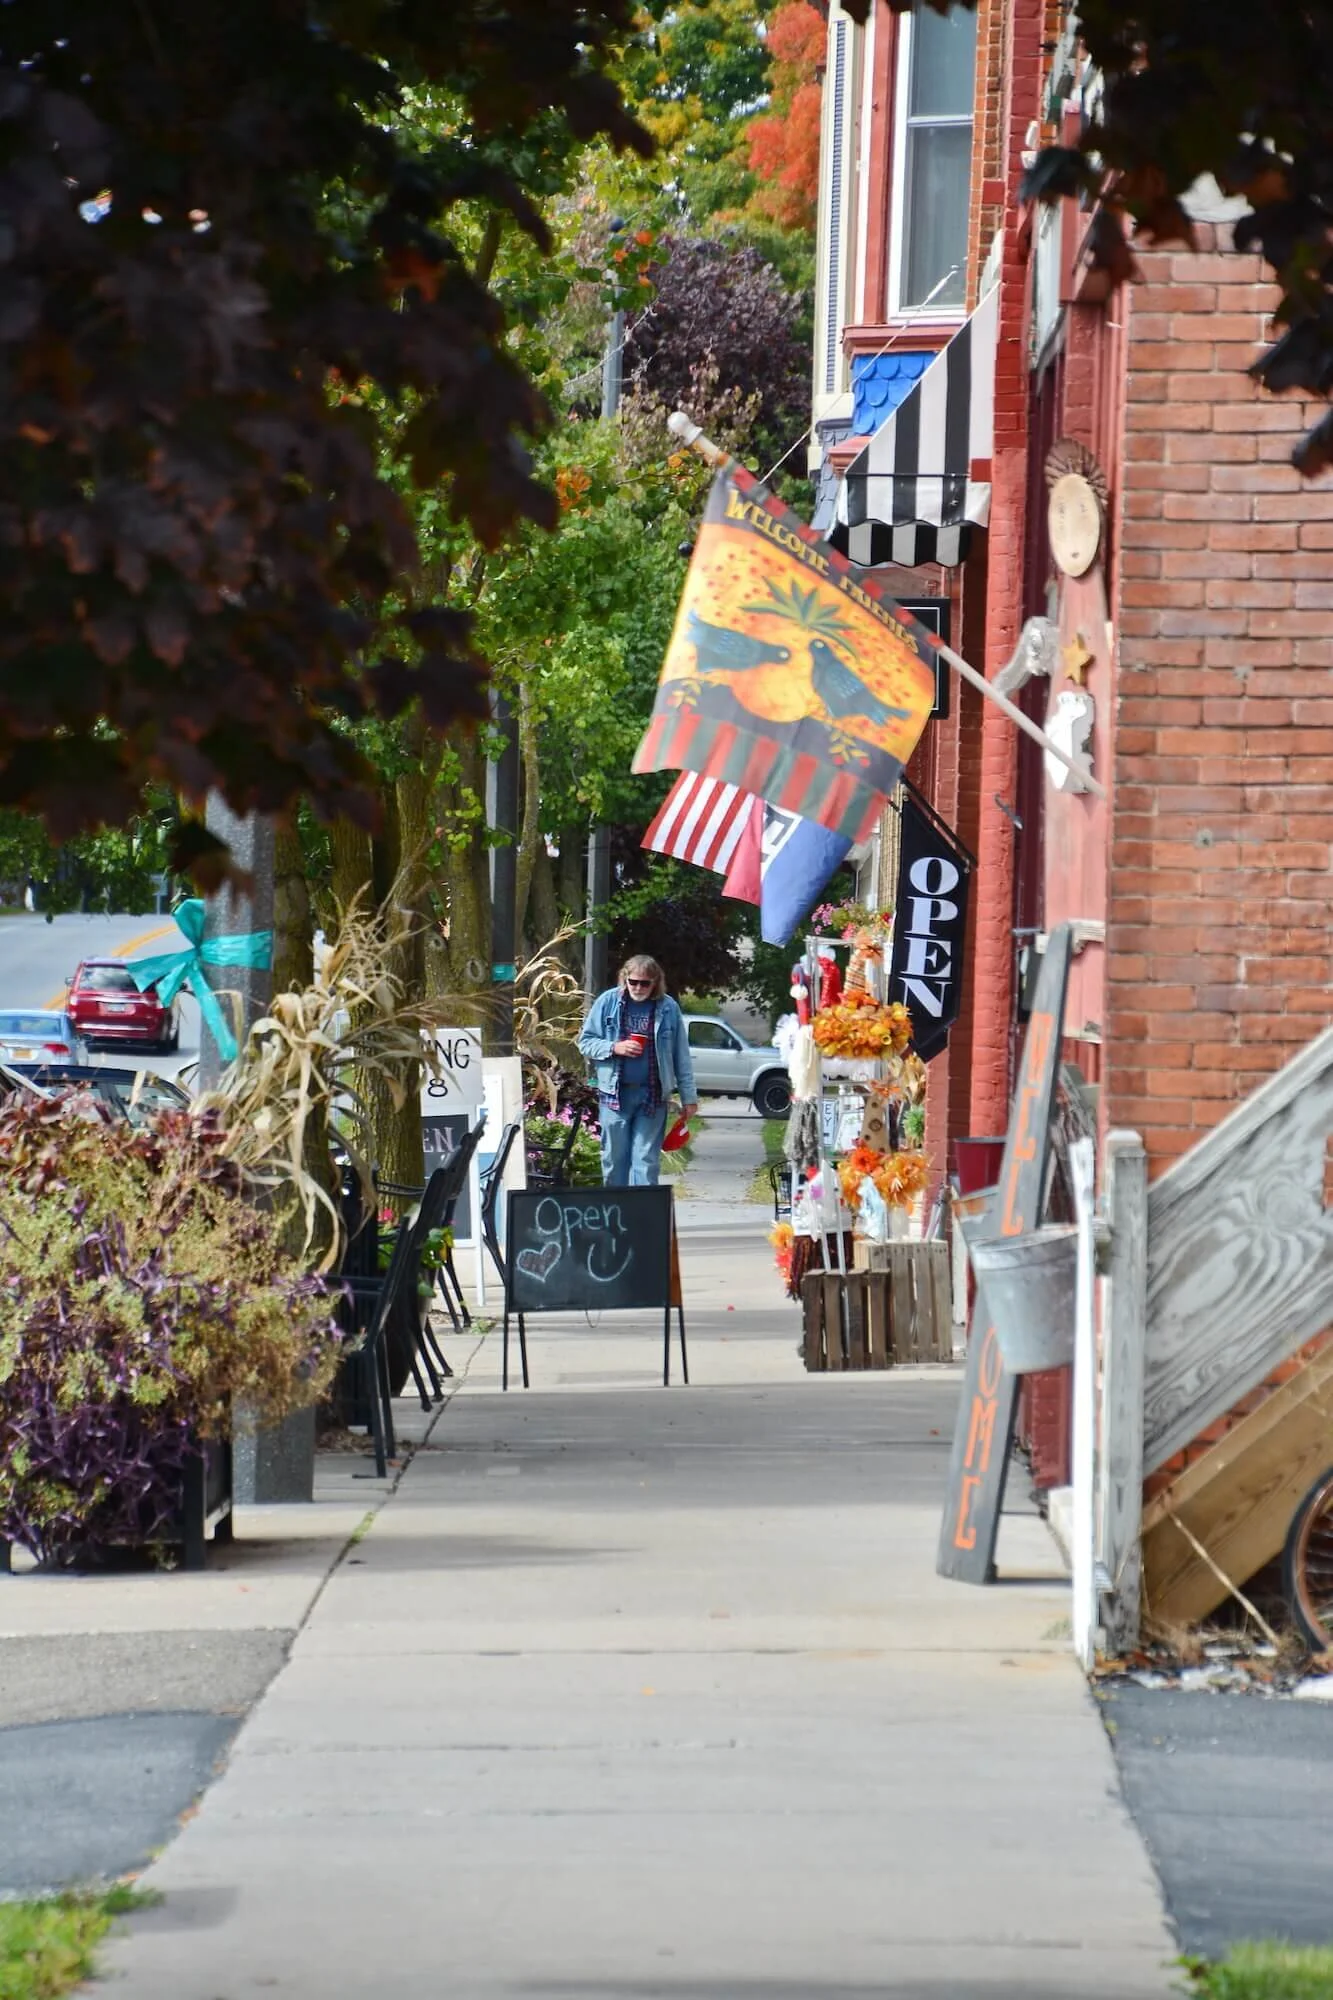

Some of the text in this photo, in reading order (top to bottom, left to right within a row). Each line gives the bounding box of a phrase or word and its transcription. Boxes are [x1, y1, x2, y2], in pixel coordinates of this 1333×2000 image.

[724, 488, 830, 577] WELCOME
[898, 856, 960, 1018] OPEN
[427, 1038, 470, 1069] NG
[535, 1197, 628, 1249] Open
[955, 1010, 1055, 1551] WELOME
